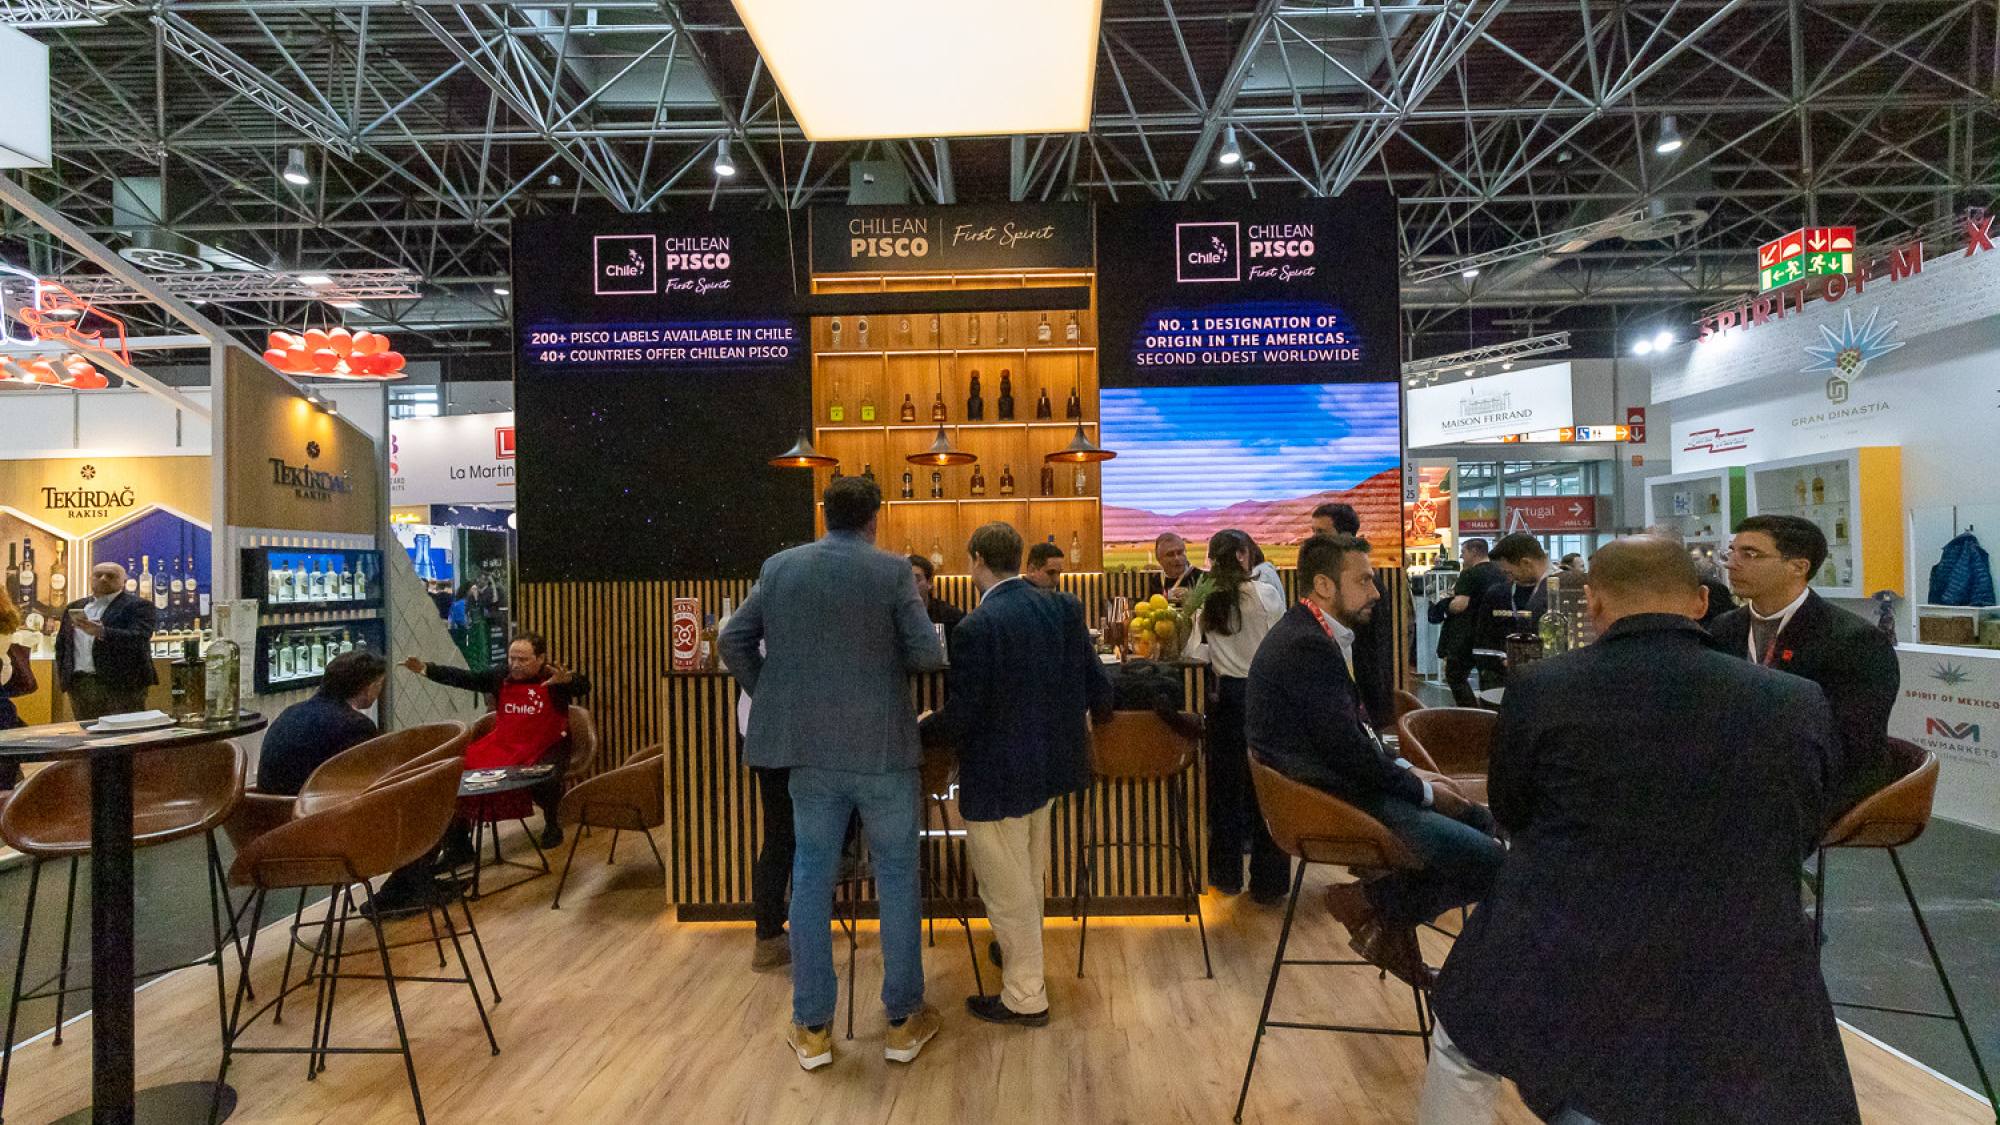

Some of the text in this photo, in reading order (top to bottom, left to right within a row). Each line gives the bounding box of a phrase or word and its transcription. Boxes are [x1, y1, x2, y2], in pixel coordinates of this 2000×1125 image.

[849, 218, 928, 235] CHILEAN
[952, 221, 1055, 248] First Spirit
[1249, 224, 1313, 239] CHILEAN
[665, 237, 729, 251] CHILEAN
[851, 237, 929, 257] PISCO
[1250, 240, 1315, 257] PISCO
[667, 253, 730, 270] PISCO
[1188, 252, 1221, 264] Chile
[606, 265, 638, 276] Chile
[1249, 264, 1316, 282] First Spirit
[665, 277, 731, 295] First Spirit
[1698, 283, 1809, 344] SPIRIT
[1159, 315, 1337, 331] NO. 1 DESIGNATION OF
[531, 328, 793, 344] 200+ PISCO LABELS AVAILABLE IN CHILE
[1146, 332, 1350, 348] ORIGIN IN THE AMERICAS.
[540, 346, 788, 362] 40+ COUNTRIES OFFER CHILEAN PISCO
[1136, 348, 1360, 365] SECOND OLDEST WORLDWIDE
[1442, 416, 1481, 430] MAISON
[1484, 409, 1533, 422] FERRAND
[1792, 414, 1824, 427] GRAN
[450, 465, 466, 479] La
[41, 486, 135, 509] TEKİRDAĞ
[68, 509, 108, 518] RAKISI
[1505, 505, 1555, 519] Ptugal
[1905, 690, 1937, 701] SPIRIT
[1957, 697, 2000, 710] MEXICO
[504, 703, 536, 715] Chile
